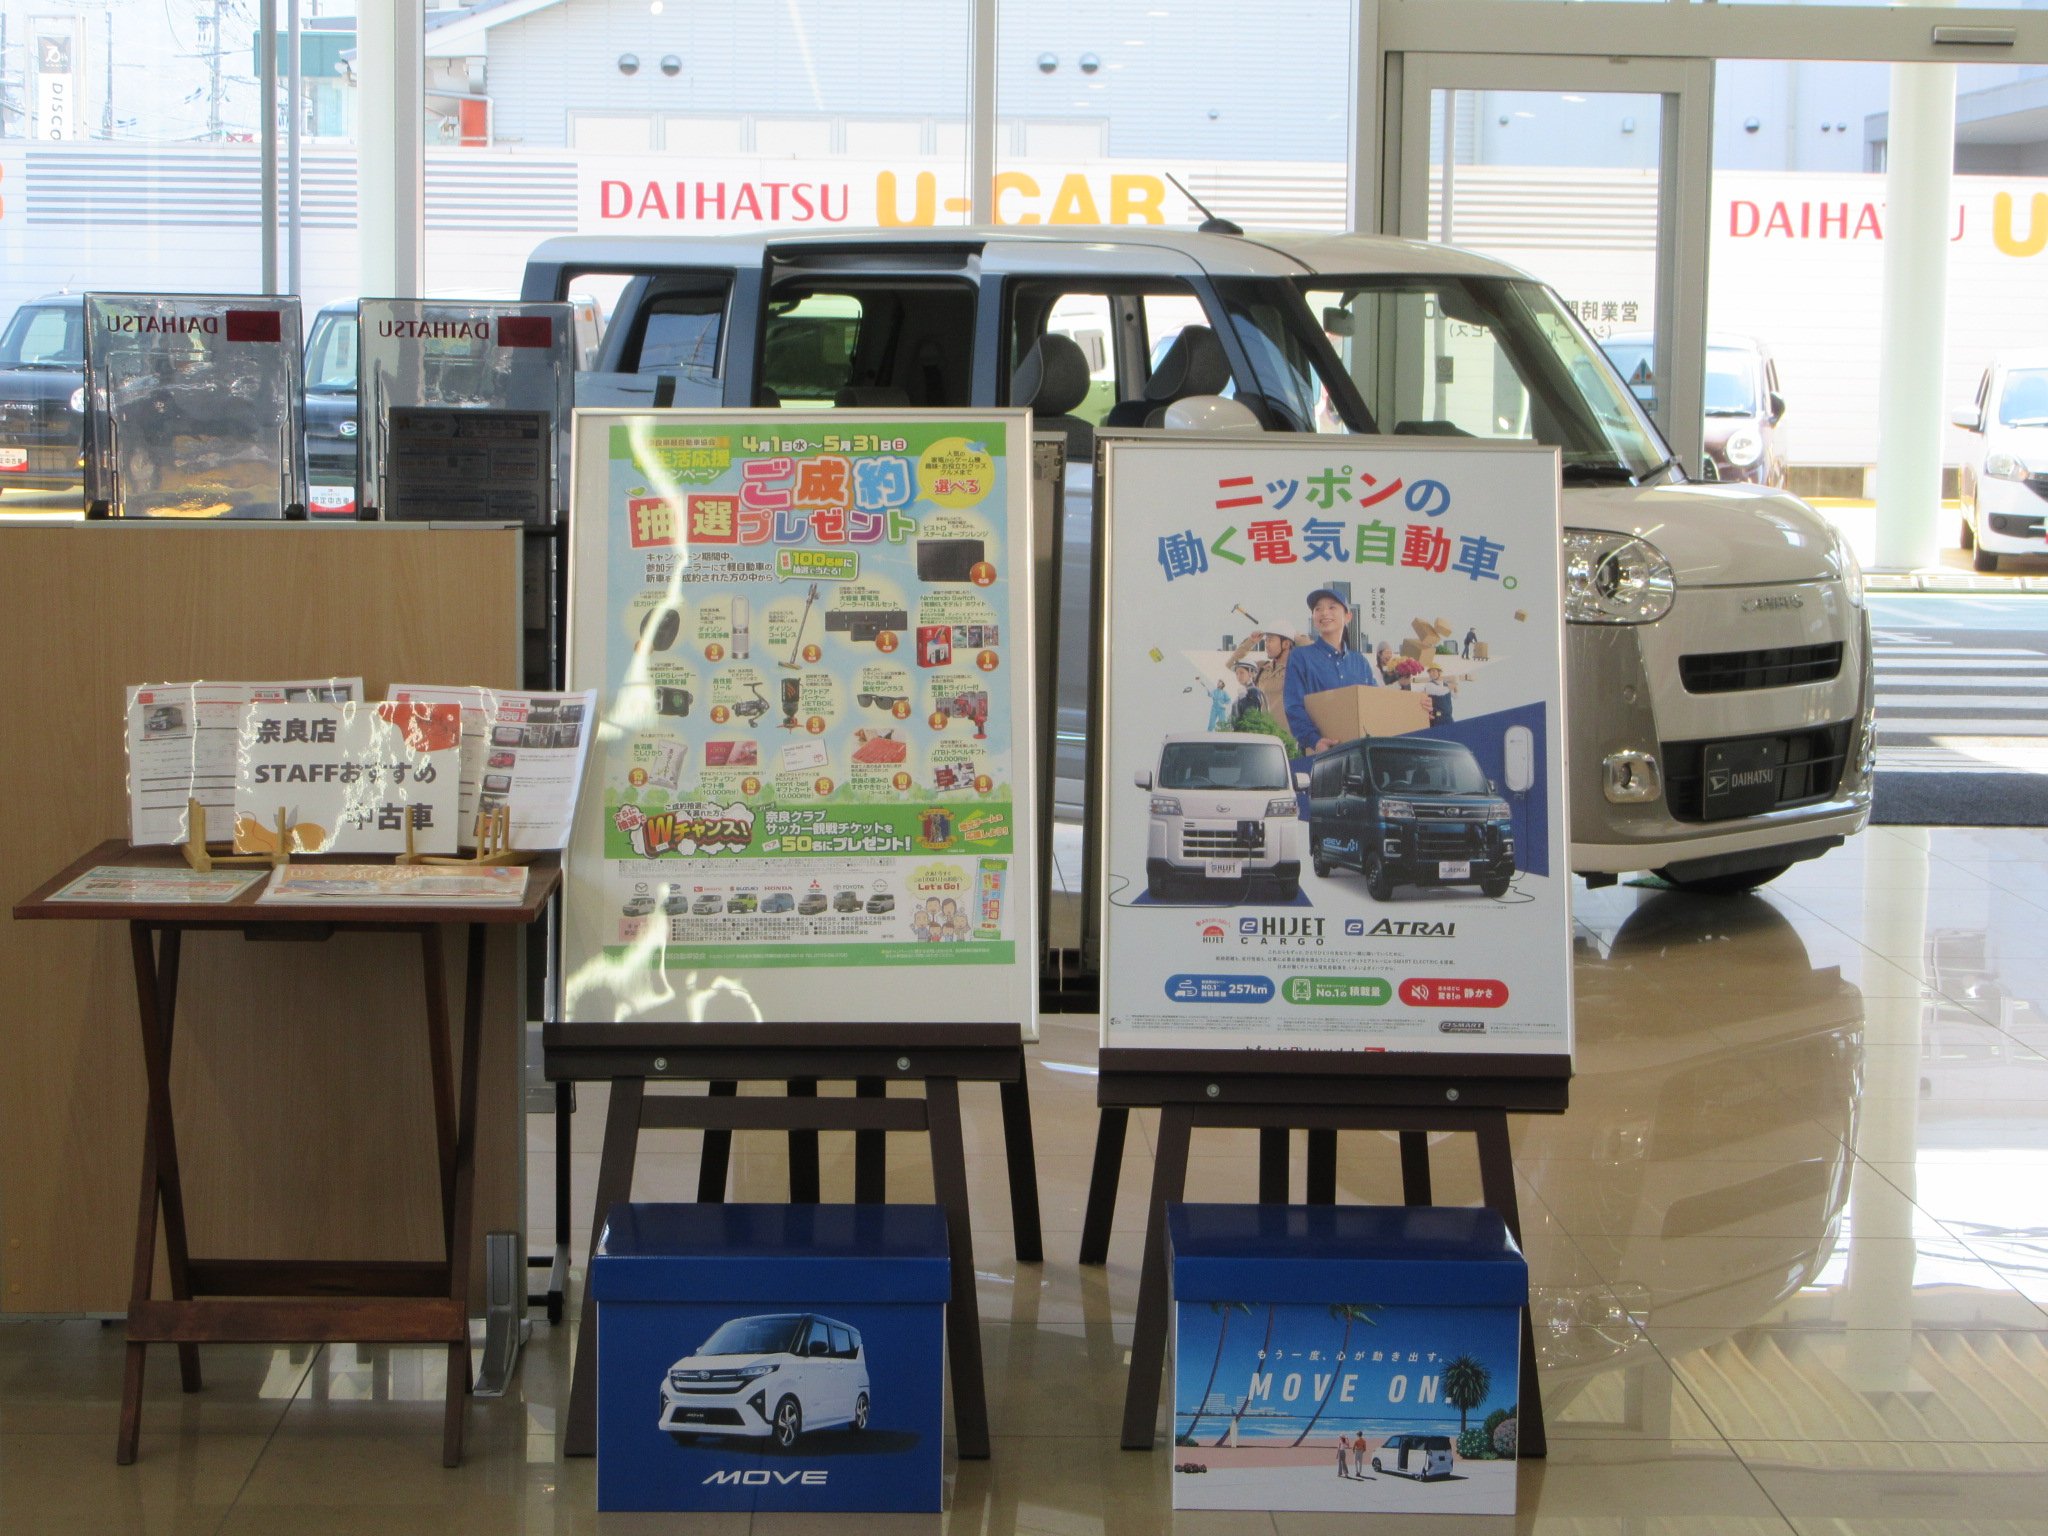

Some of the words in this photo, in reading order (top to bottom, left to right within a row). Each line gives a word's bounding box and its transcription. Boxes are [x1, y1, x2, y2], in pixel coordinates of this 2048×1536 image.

[600, 180, 849, 222] DAIHATSU
[876, 170, 1166, 227] U-CAR
[739, 456, 911, 509] ご成約
[934, 479, 980, 494] 選べる
[1215, 465, 1451, 517] ニッポンの
[1157, 517, 1518, 590] 働く電気自動車。
[646, 573, 774, 582] 新車を成約された方の中から
[979, 565, 987, 578] 1
[884, 634, 890, 646] 1
[712, 645, 718, 656] 3
[809, 646, 816, 656] 3
[984, 653, 990, 664] 1
[717, 706, 724, 718] 3
[812, 718, 820, 728] 5
[256, 718, 337, 744] 奈良店
[1732, 768, 1774, 789] DAIHATSU
[765, 810, 827, 824] 奈良クラブ
[648, 816, 749, 848] Wチャンス!
[766, 822, 894, 835] サッカー観戦チケットを
[781, 836, 912, 852] 50名にプレゼント!
[918, 882, 942, 891] Let's
[944, 882, 960, 891] Go!
[1262, 916, 1326, 936] HIJET
[1366, 918, 1456, 936] ATRAI
[1240, 938, 1324, 946] CARGO
[1228, 984, 1268, 994] 257km
[1316, 988, 1348, 998] No.1の
[1464, 988, 1494, 998] 静かさ
[1257, 1350, 1444, 1362] もう一度、心が動き出す。
[1249, 1372, 1358, 1402] MOVE
[702, 1470, 829, 1485] MOVE
